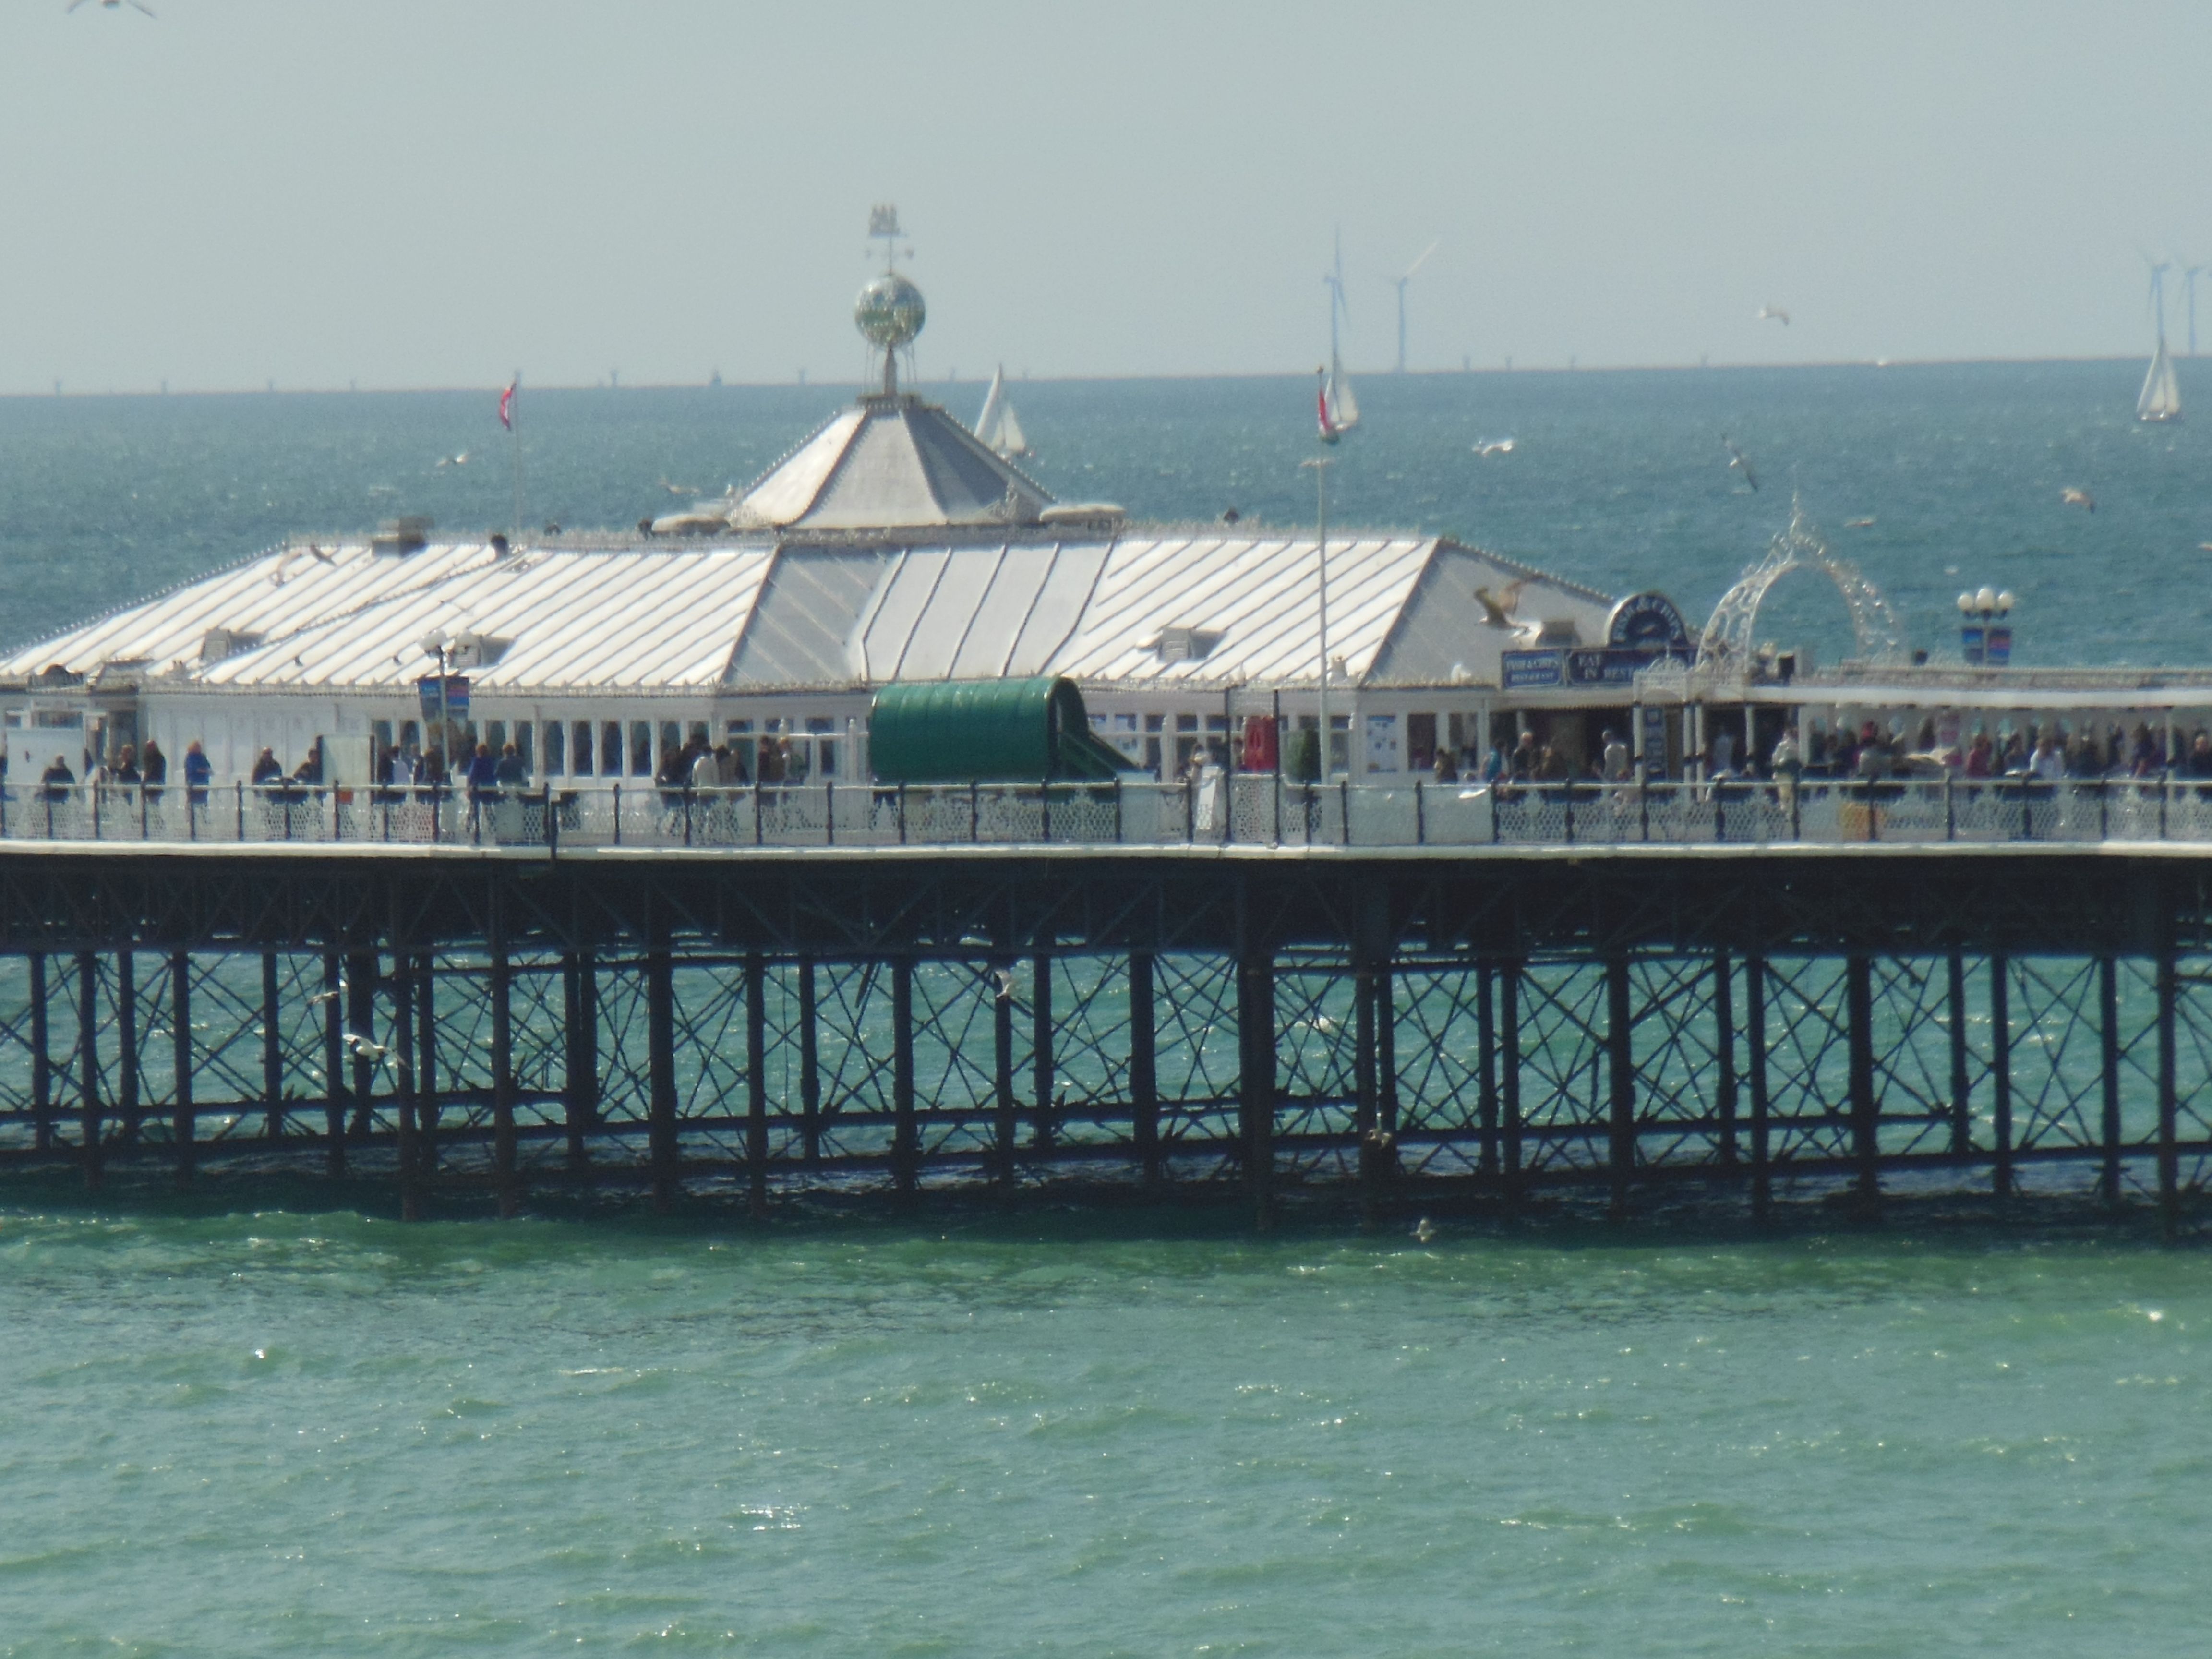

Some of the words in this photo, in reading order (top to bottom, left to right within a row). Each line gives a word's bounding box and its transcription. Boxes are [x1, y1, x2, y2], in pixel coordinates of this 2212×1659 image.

[1612, 604, 1635, 642] FISH
[1636, 597, 1649, 611] &
[1651, 599, 1682, 641] CHIPS
